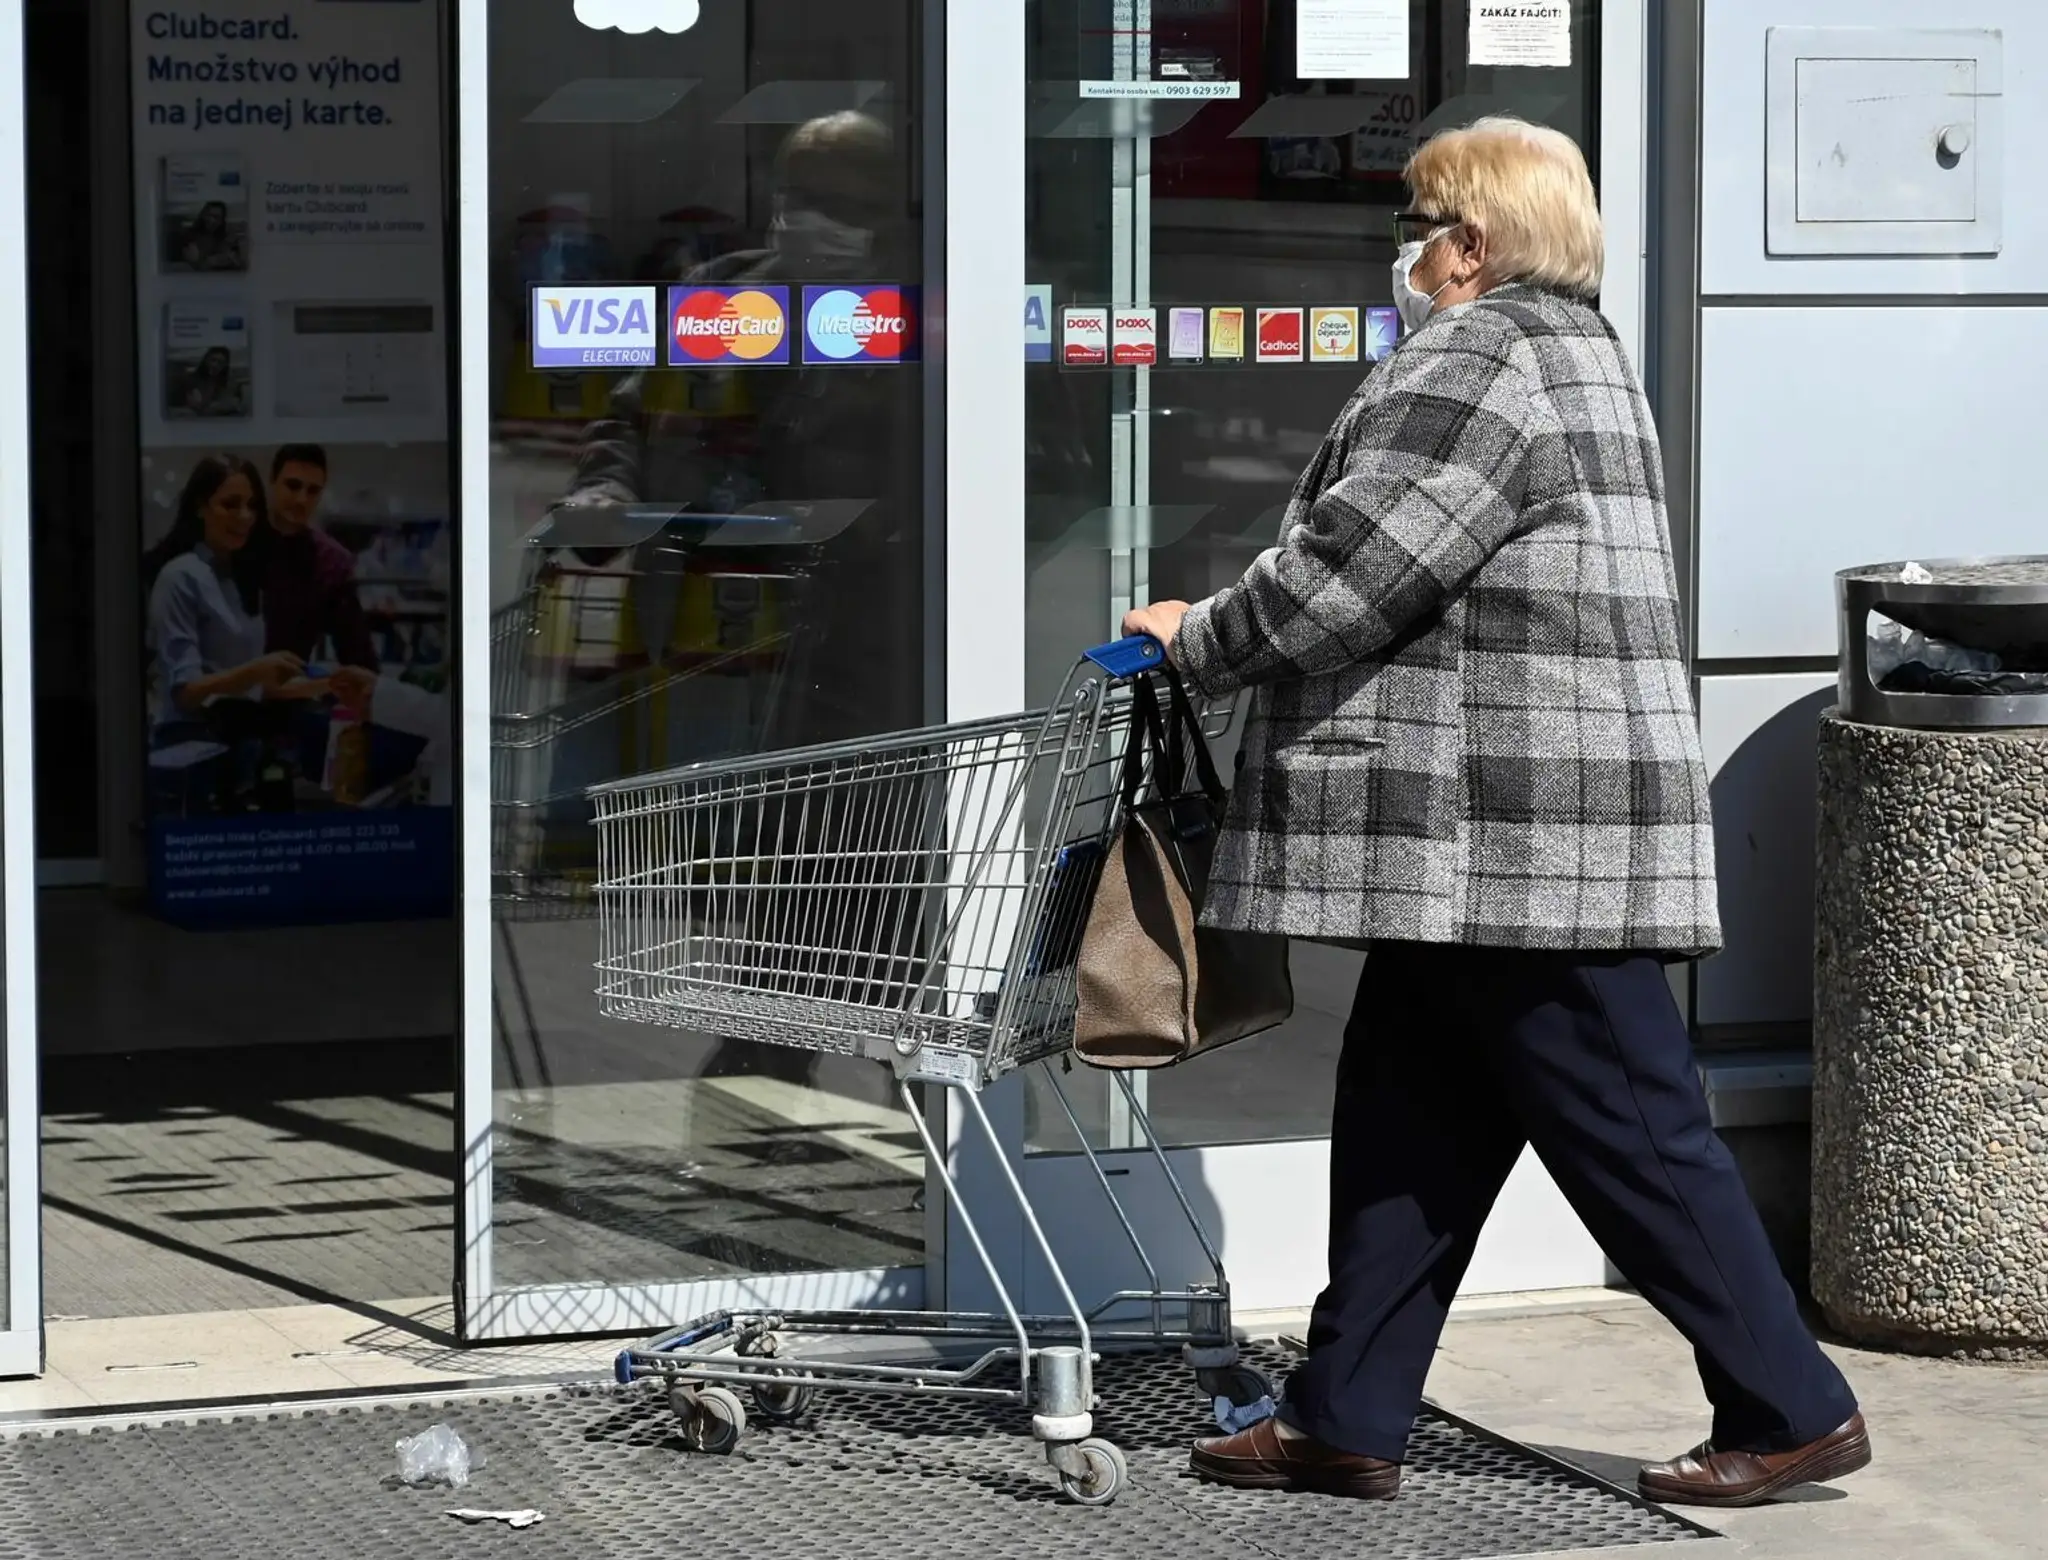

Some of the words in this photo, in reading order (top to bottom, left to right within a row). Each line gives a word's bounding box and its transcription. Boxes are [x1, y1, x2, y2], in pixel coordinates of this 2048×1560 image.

[1480, 6, 1517, 18] ZÁKAZ
[147, 12, 299, 39] Clubcard.
[147, 54, 297, 82] Množstvo
[308, 56, 401, 90] výhod
[1166, 86, 1191, 95] 0903
[1193, 86, 1211, 95] 629
[1213, 86, 1231, 95] 597
[149, 103, 185, 124] na
[194, 98, 292, 131] jednej
[303, 98, 393, 125] karte.
[543, 298, 651, 335] VISA
[676, 314, 783, 338] MasterCard
[817, 314, 907, 337] Maestro
[1116, 319, 1153, 333] DOXX
[582, 349, 651, 363] ELECTRON
[1260, 340, 1299, 351] Cadhoc
